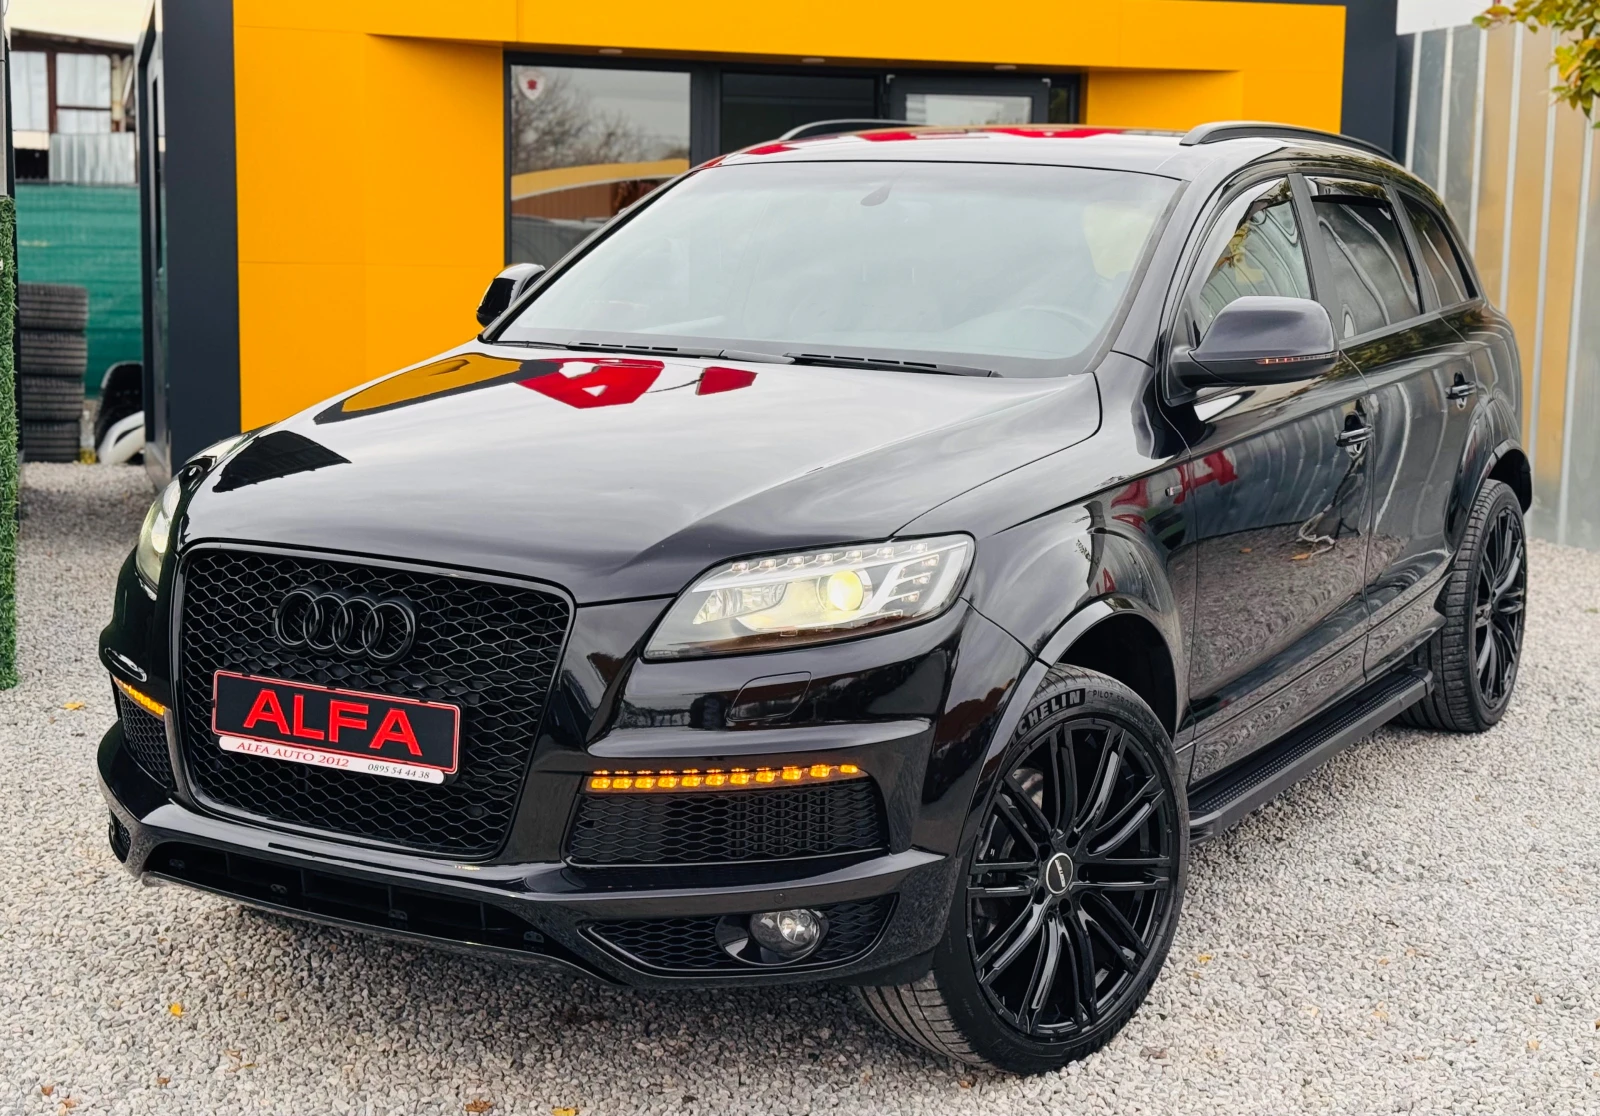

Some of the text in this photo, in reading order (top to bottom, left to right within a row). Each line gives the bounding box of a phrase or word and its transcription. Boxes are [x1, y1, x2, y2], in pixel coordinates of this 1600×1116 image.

[1092, 689, 1113, 699] PILOT
[243, 688, 423, 756] ALFA
[236, 742, 350, 768] ALFA AUTO 2012
[367, 763, 430, 779] 0895 54 44 38
